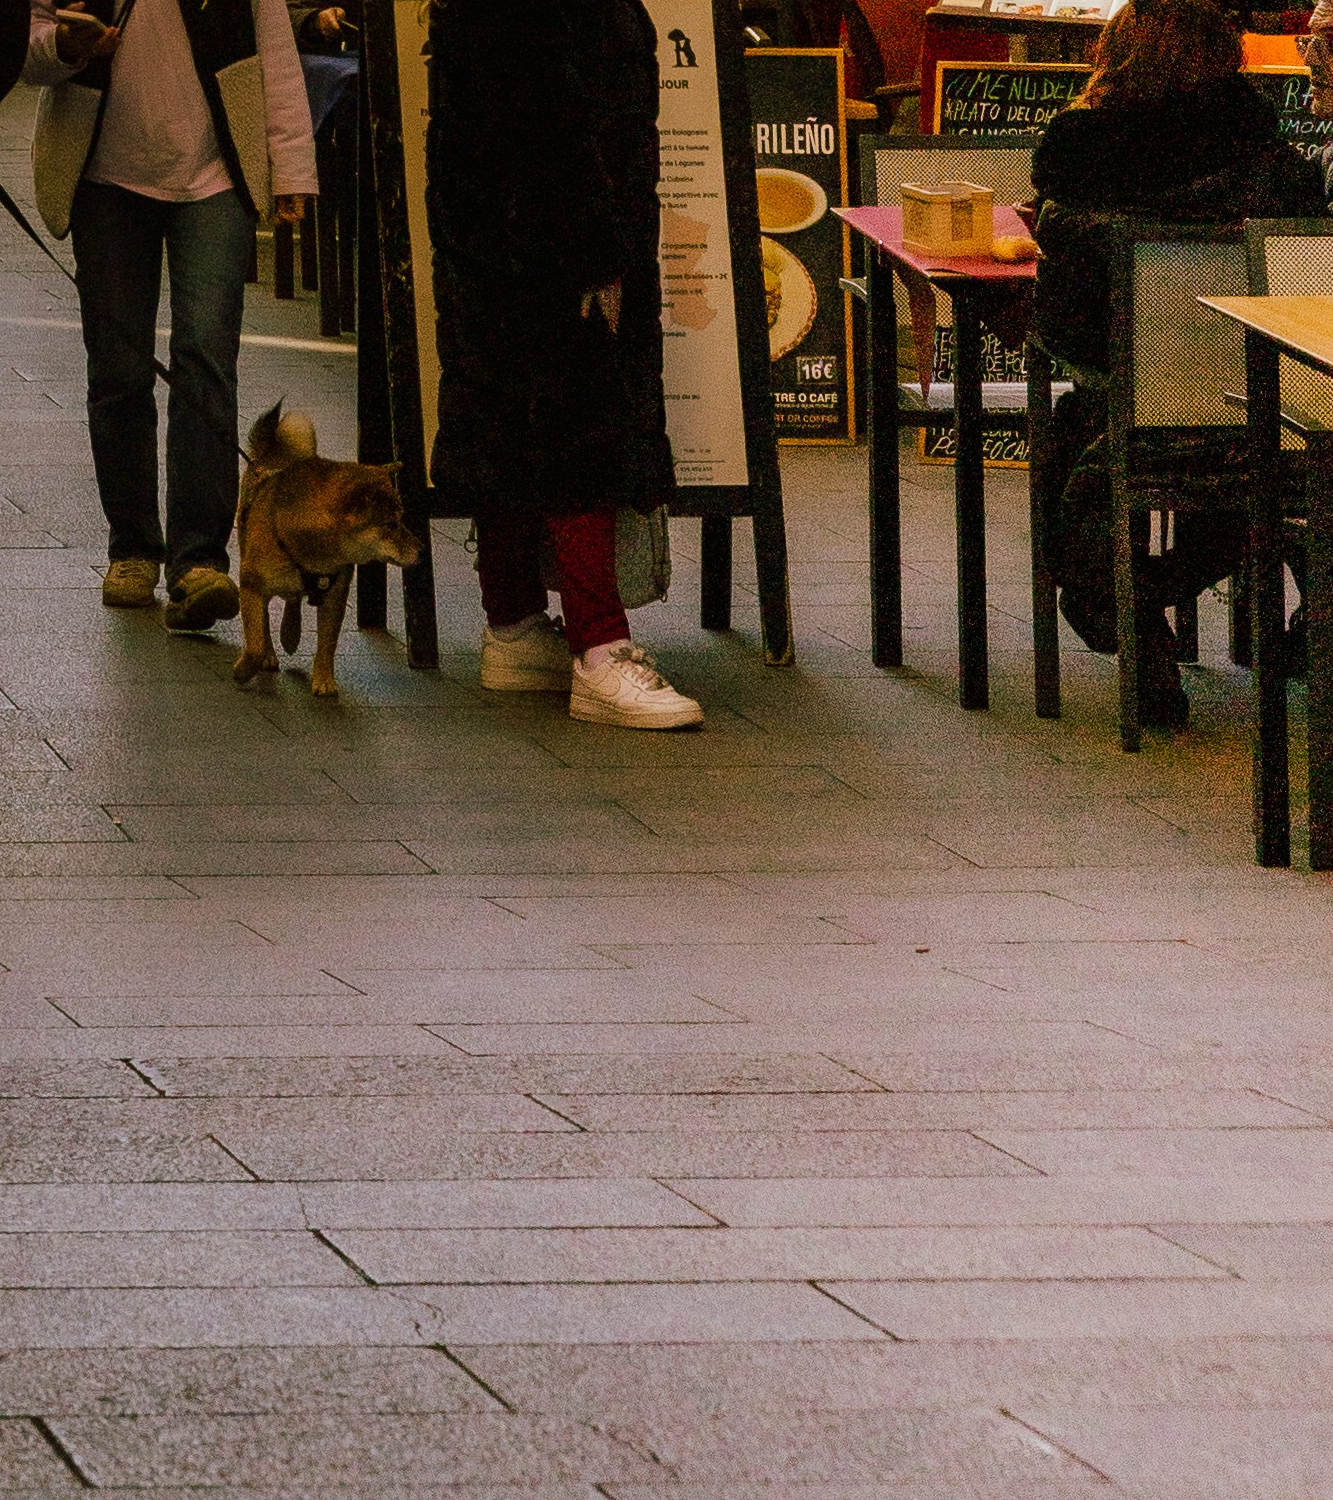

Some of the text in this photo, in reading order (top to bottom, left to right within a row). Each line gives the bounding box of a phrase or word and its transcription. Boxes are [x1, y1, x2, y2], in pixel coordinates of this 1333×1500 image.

[659, 79, 689, 90] JOUR
[754, 116, 835, 155] RILEÑO
[801, 362, 834, 380] 16€
[770, 391, 838, 403] TRE O CAFÉ
